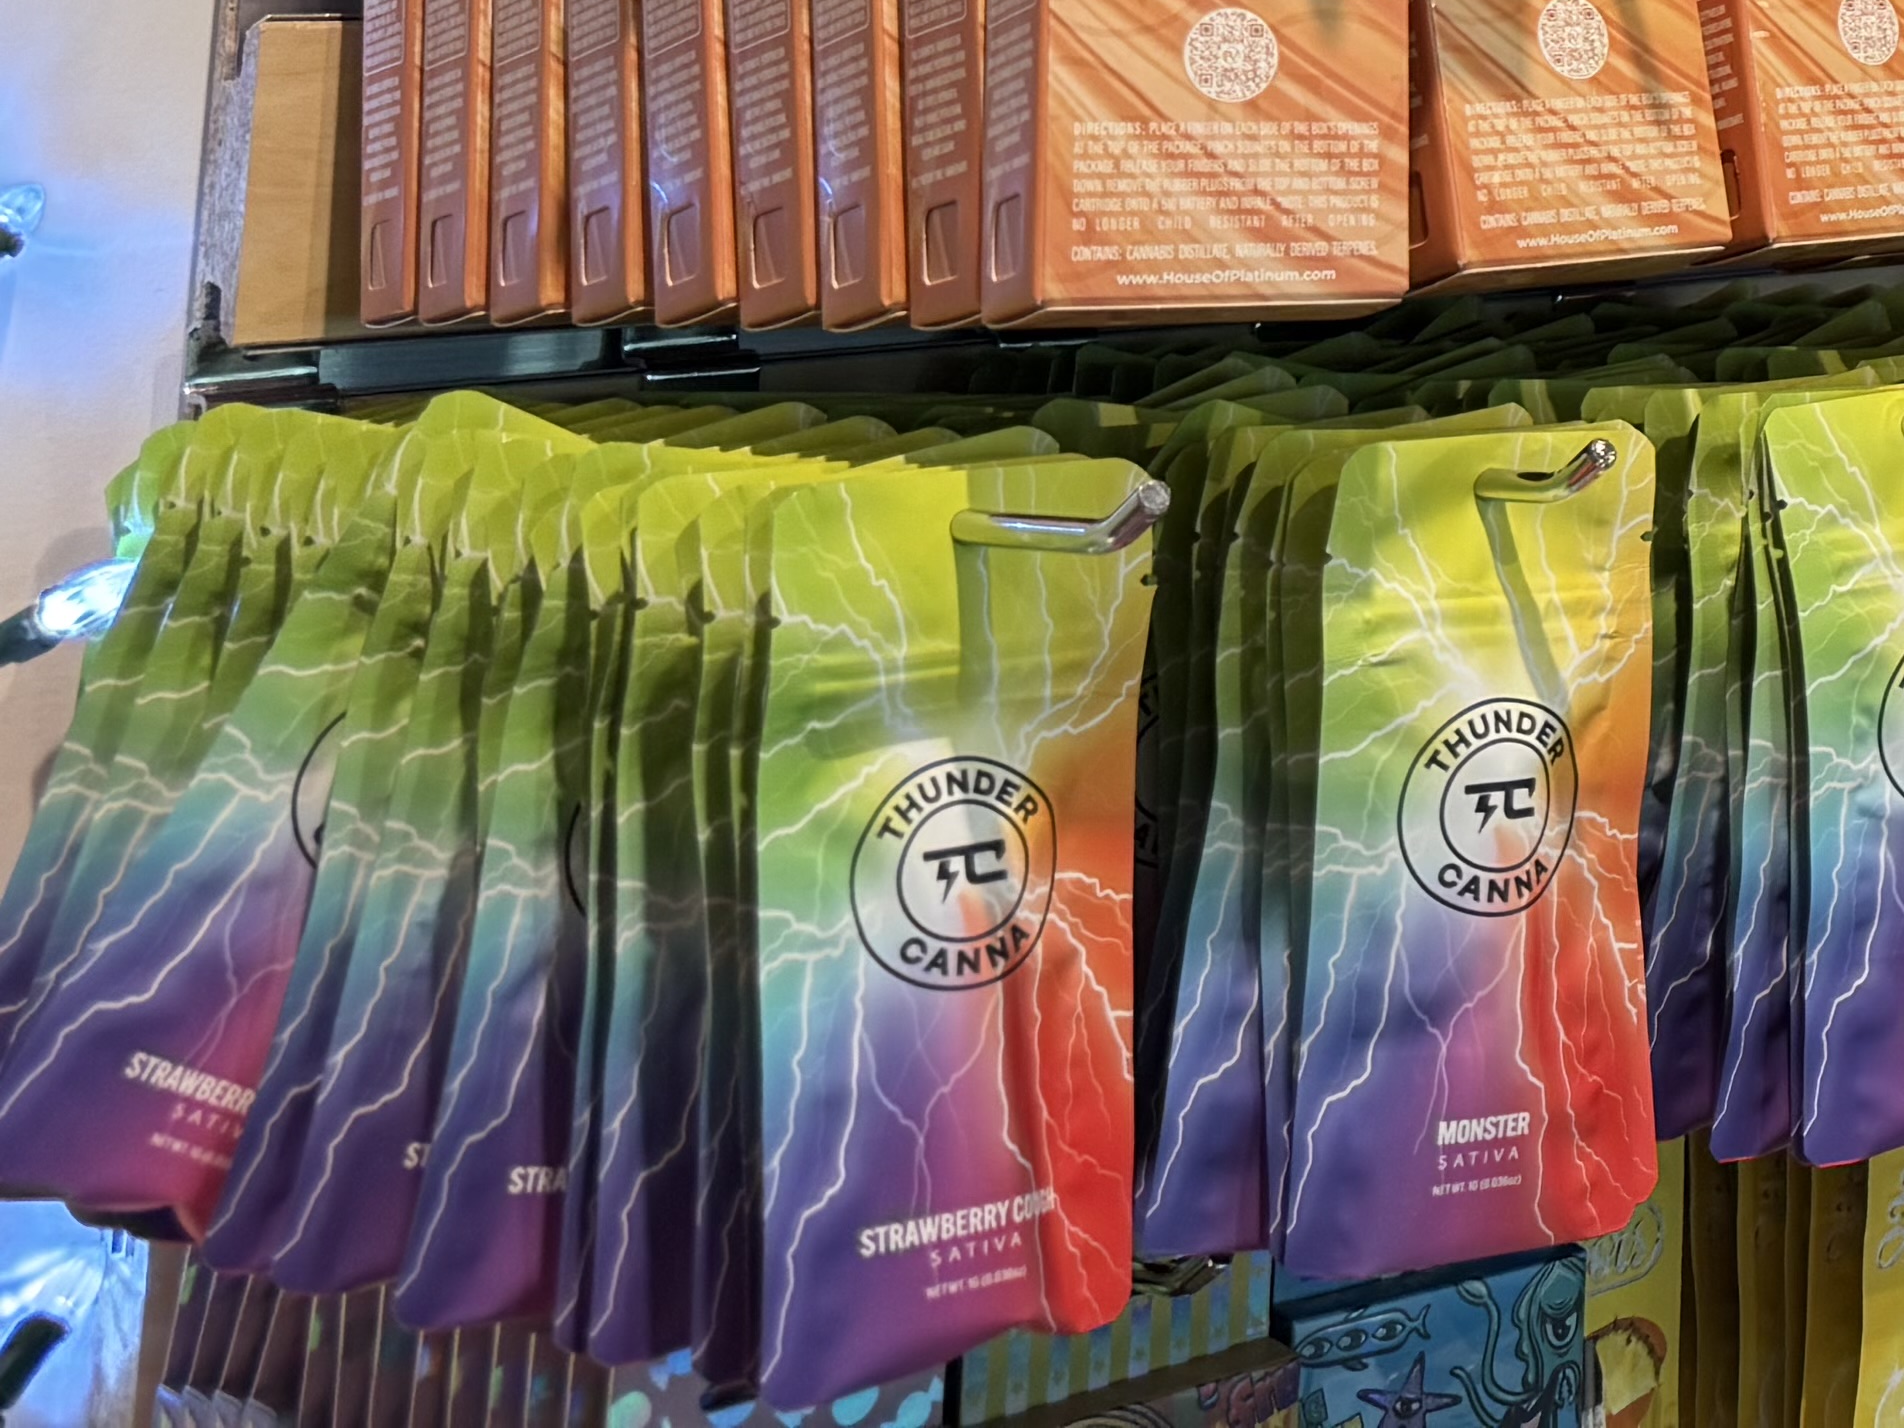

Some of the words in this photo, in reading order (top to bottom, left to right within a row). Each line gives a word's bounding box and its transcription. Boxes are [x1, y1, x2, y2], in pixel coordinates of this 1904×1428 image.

[1517, 224, 1678, 249] www.HouseOfPlatinum.com
[1117, 268, 1336, 285] www.HouseOfPlatinum.com
[1424, 705, 1566, 776] THUNDER
[877, 764, 1042, 846] THUNDER
[1437, 857, 1551, 906] CANNA
[895, 919, 1033, 980] CANNA
[1436, 1111, 1531, 1146] MONSTER
[1436, 1145, 1521, 1172] SATIVA
[857, 1196, 1008, 1258] STRAWBERRY
[928, 1230, 1024, 1268] SATIVA
